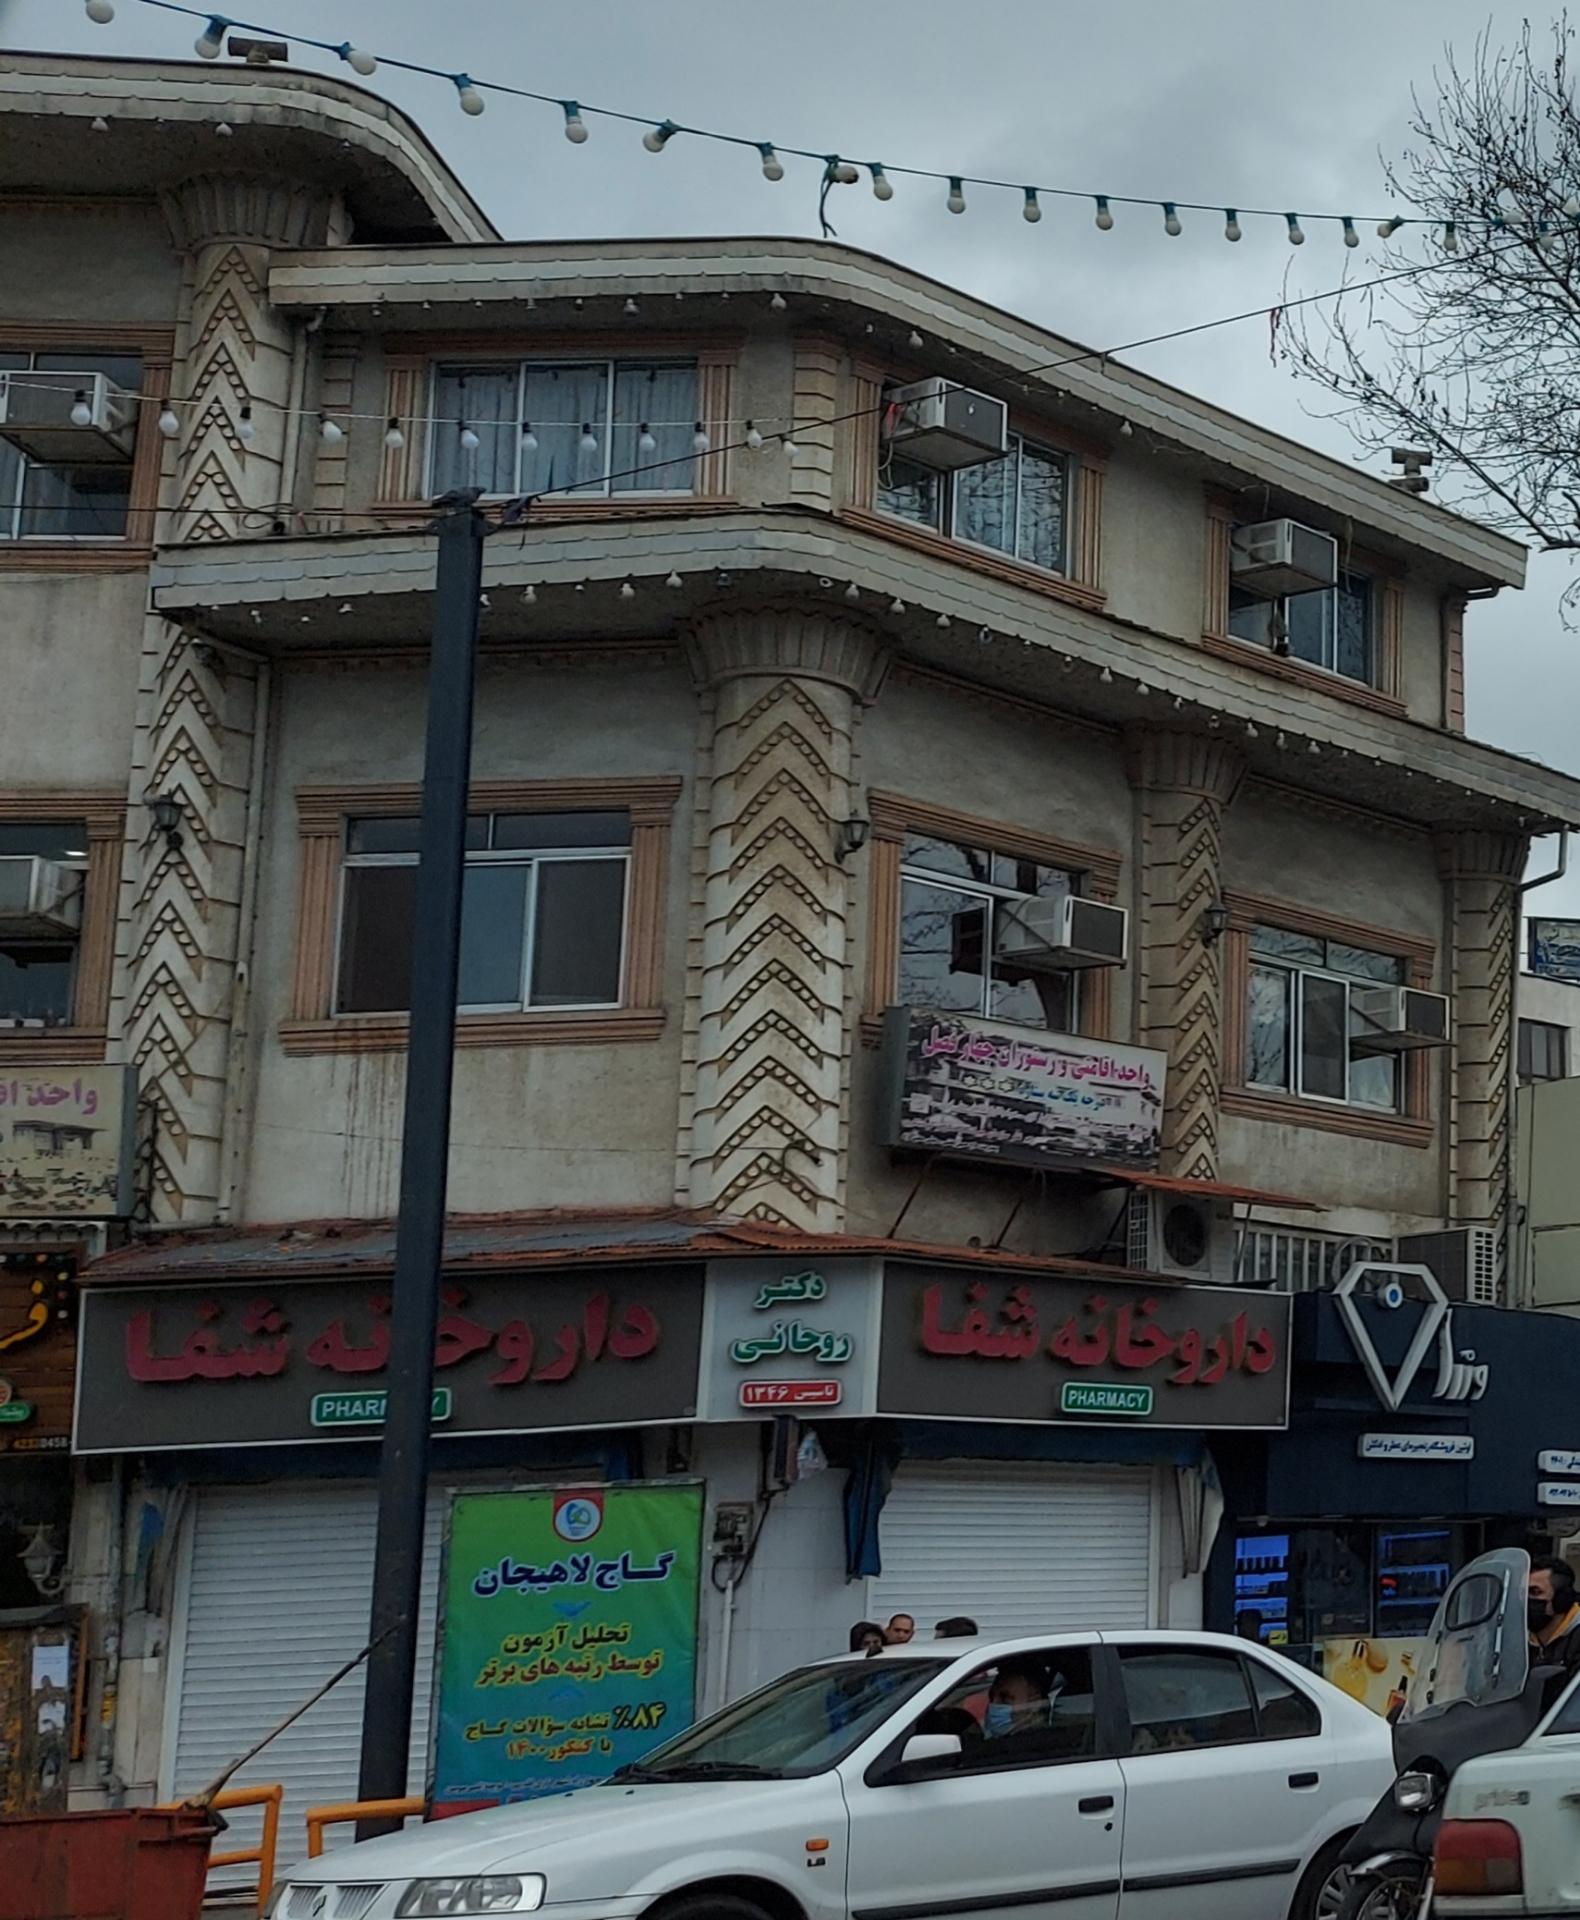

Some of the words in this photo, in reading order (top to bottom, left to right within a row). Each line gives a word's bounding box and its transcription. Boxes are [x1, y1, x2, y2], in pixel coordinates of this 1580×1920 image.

[27, 1077, 98, 1115] واحد
[754, 1271, 826, 1309] دکتر
[920, 1282, 1040, 1360] شفا
[126, 1300, 290, 1383] شفا
[731, 1320, 853, 1363] روحانی
[1050, 1292, 1277, 1385] داروخانه
[1067, 1389, 1146, 1410] PHARMACY
[473, 1554, 592, 1597] لاهیجان
[594, 1551, 675, 1590] گاج
[503, 1625, 568, 1654] آزمون
[572, 1624, 630, 1651] تحلیل
[476, 1663, 517, 1686] برتر
[521, 1655, 560, 1683] های
[564, 1658, 604, 1679] رتبه
[608, 1650, 662, 1679] توسط
[465, 1720, 508, 1742] گاج
[507, 1741, 546, 1760] ۱۴۰۰
[546, 1737, 594, 1761] کنکور
